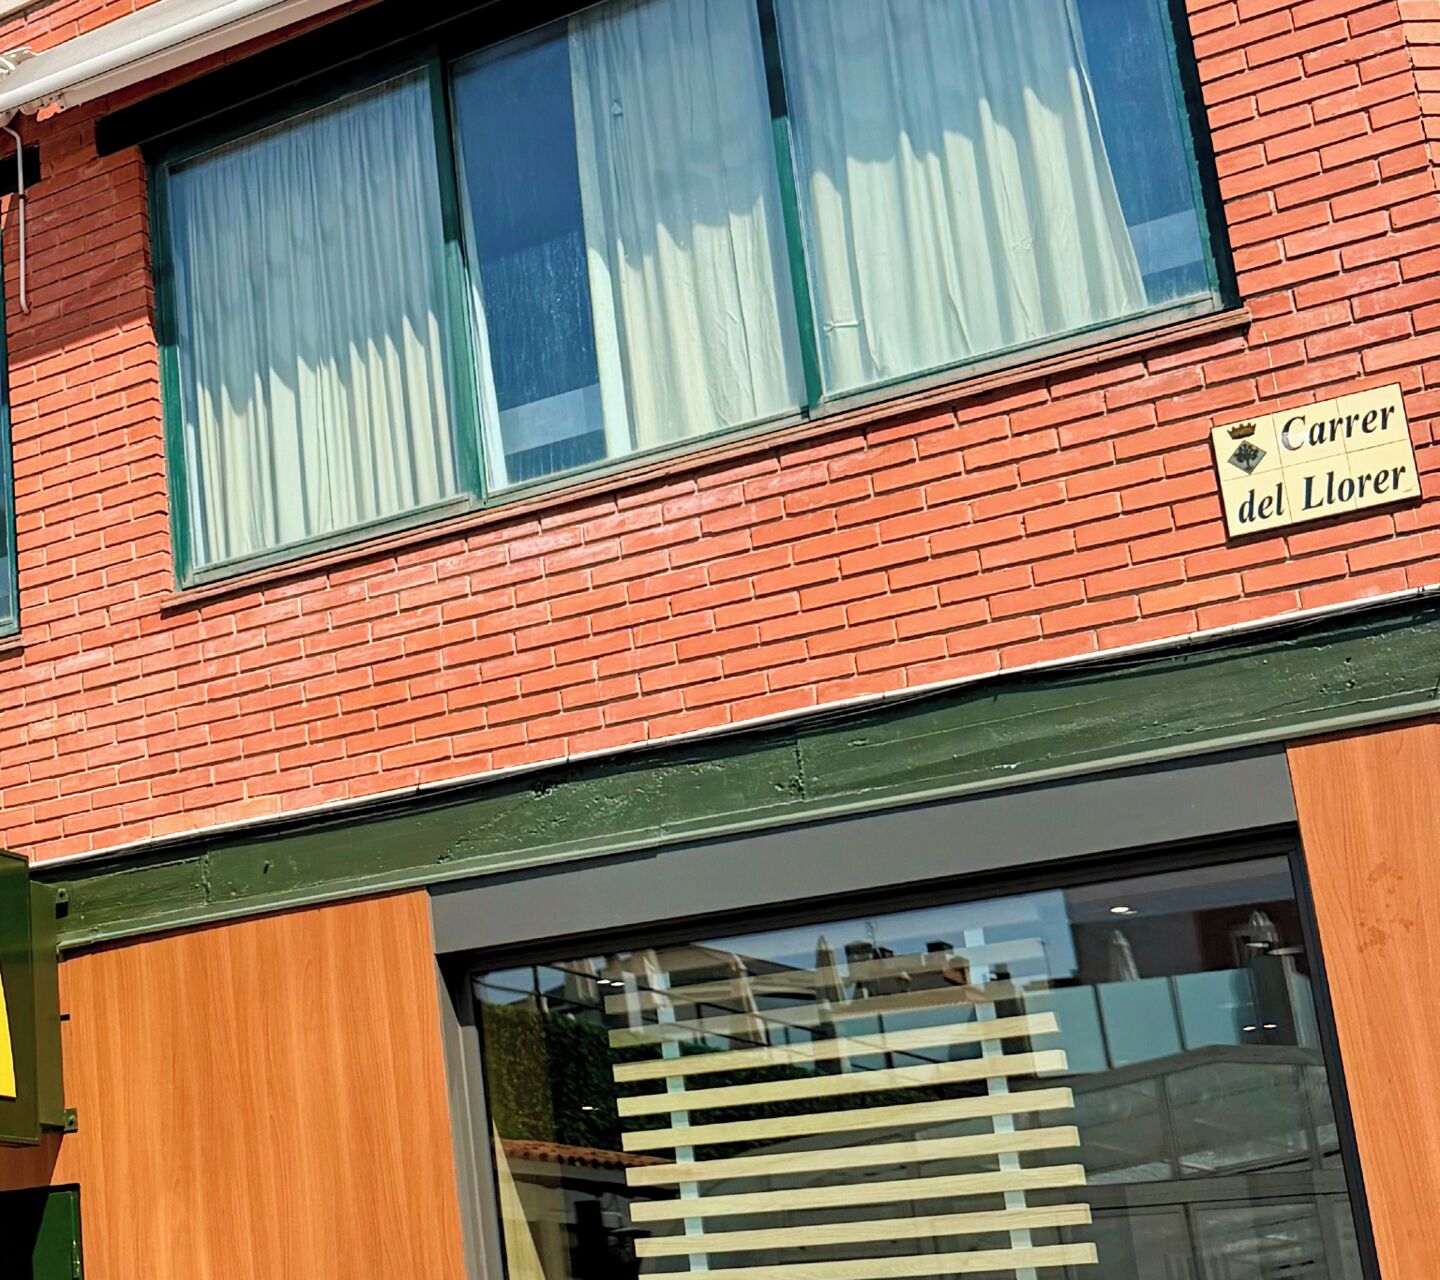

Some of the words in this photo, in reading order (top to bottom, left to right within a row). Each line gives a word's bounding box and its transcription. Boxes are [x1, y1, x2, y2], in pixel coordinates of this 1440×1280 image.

[1281, 405, 1395, 451] Carrer
[1238, 482, 1285, 524] del
[1301, 465, 1406, 511] Llorer
